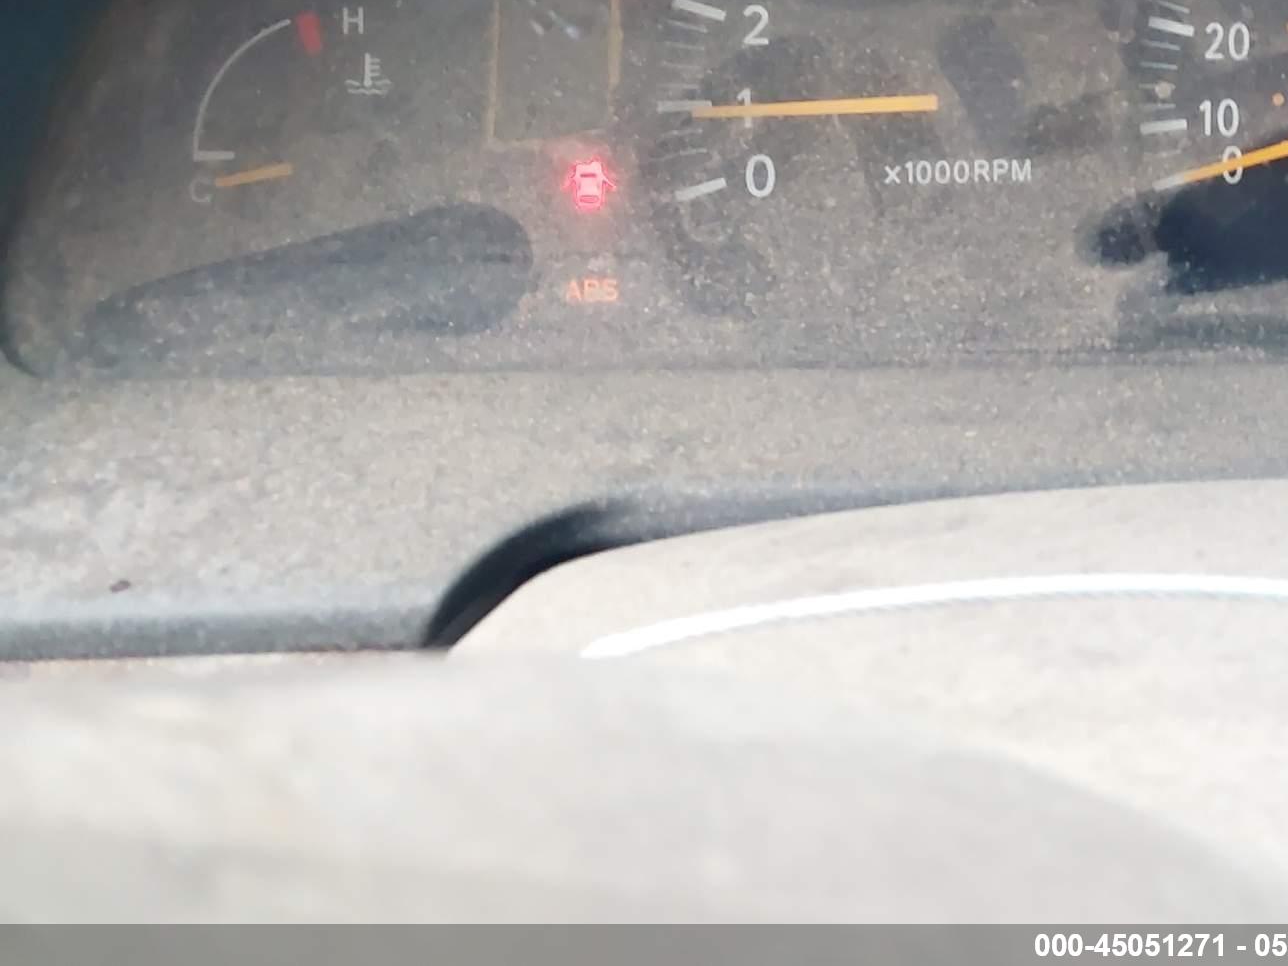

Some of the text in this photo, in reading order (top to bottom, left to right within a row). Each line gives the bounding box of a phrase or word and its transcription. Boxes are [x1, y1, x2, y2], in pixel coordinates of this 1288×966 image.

[342, 8, 364, 34] H
[743, 5, 769, 46] 2
[1206, 23, 1250, 61] 20
[737, 88, 753, 128] 1
[1199, 98, 1239, 137] 10
[745, 154, 776, 198] 0
[884, 159, 1032, 185] x1000RPM
[1222, 145, 1243, 184] 0
